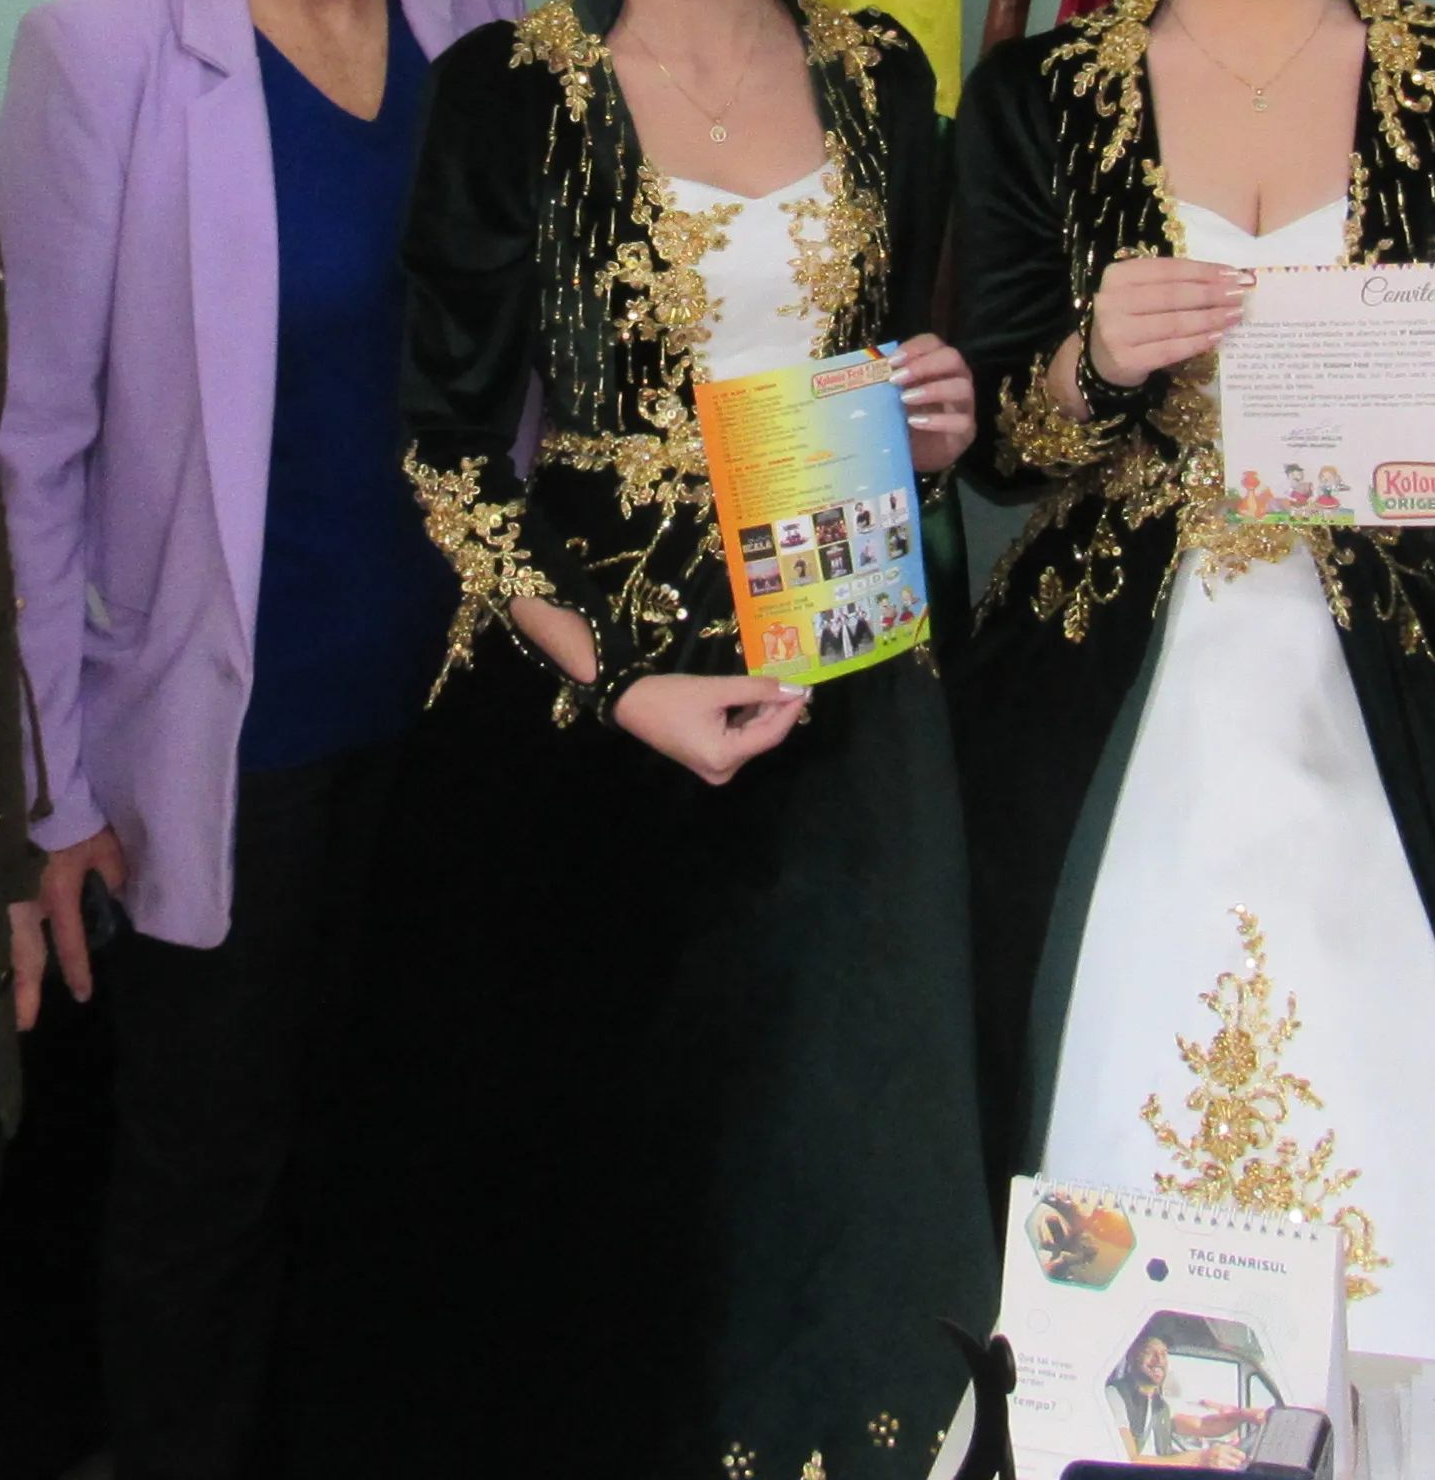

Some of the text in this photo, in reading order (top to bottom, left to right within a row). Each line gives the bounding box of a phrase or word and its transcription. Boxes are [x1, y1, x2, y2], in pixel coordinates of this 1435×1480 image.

[1189, 1248, 1287, 1274] TAG BANRISUL
[1188, 1263, 1232, 1281] VELOE
[1013, 1396, 1057, 1412] tempo?
